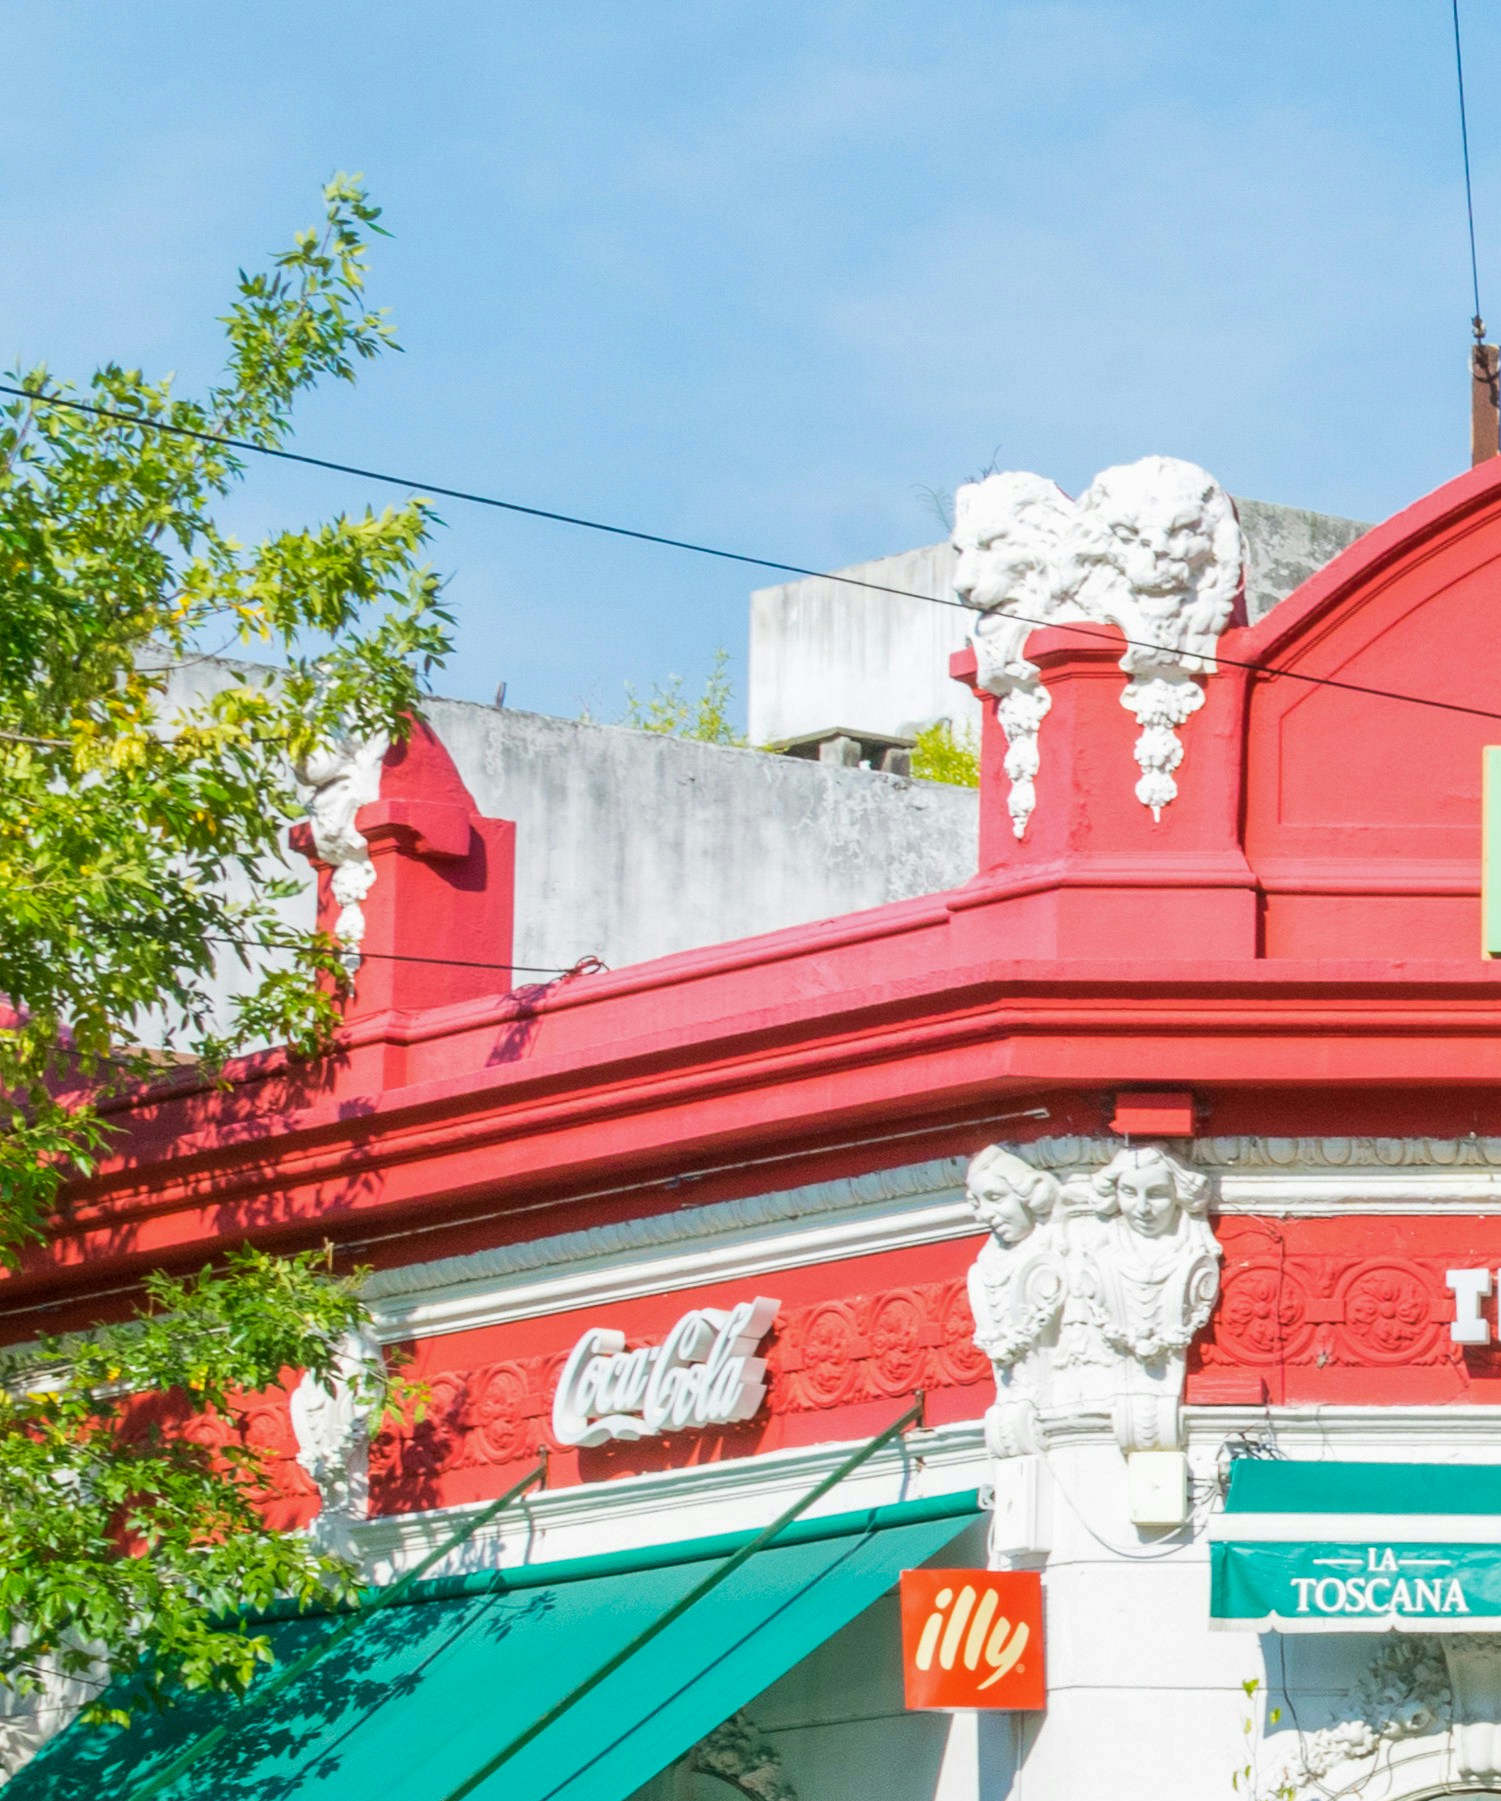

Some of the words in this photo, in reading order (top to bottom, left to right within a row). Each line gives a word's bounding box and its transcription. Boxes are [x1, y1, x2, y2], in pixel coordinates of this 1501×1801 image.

[552, 1297, 778, 1447] Coca-Cola
[1367, 1547, 1399, 1572] LA
[1290, 1577, 1470, 1613] TOSCANA
[915, 1585, 1030, 1690] illy
